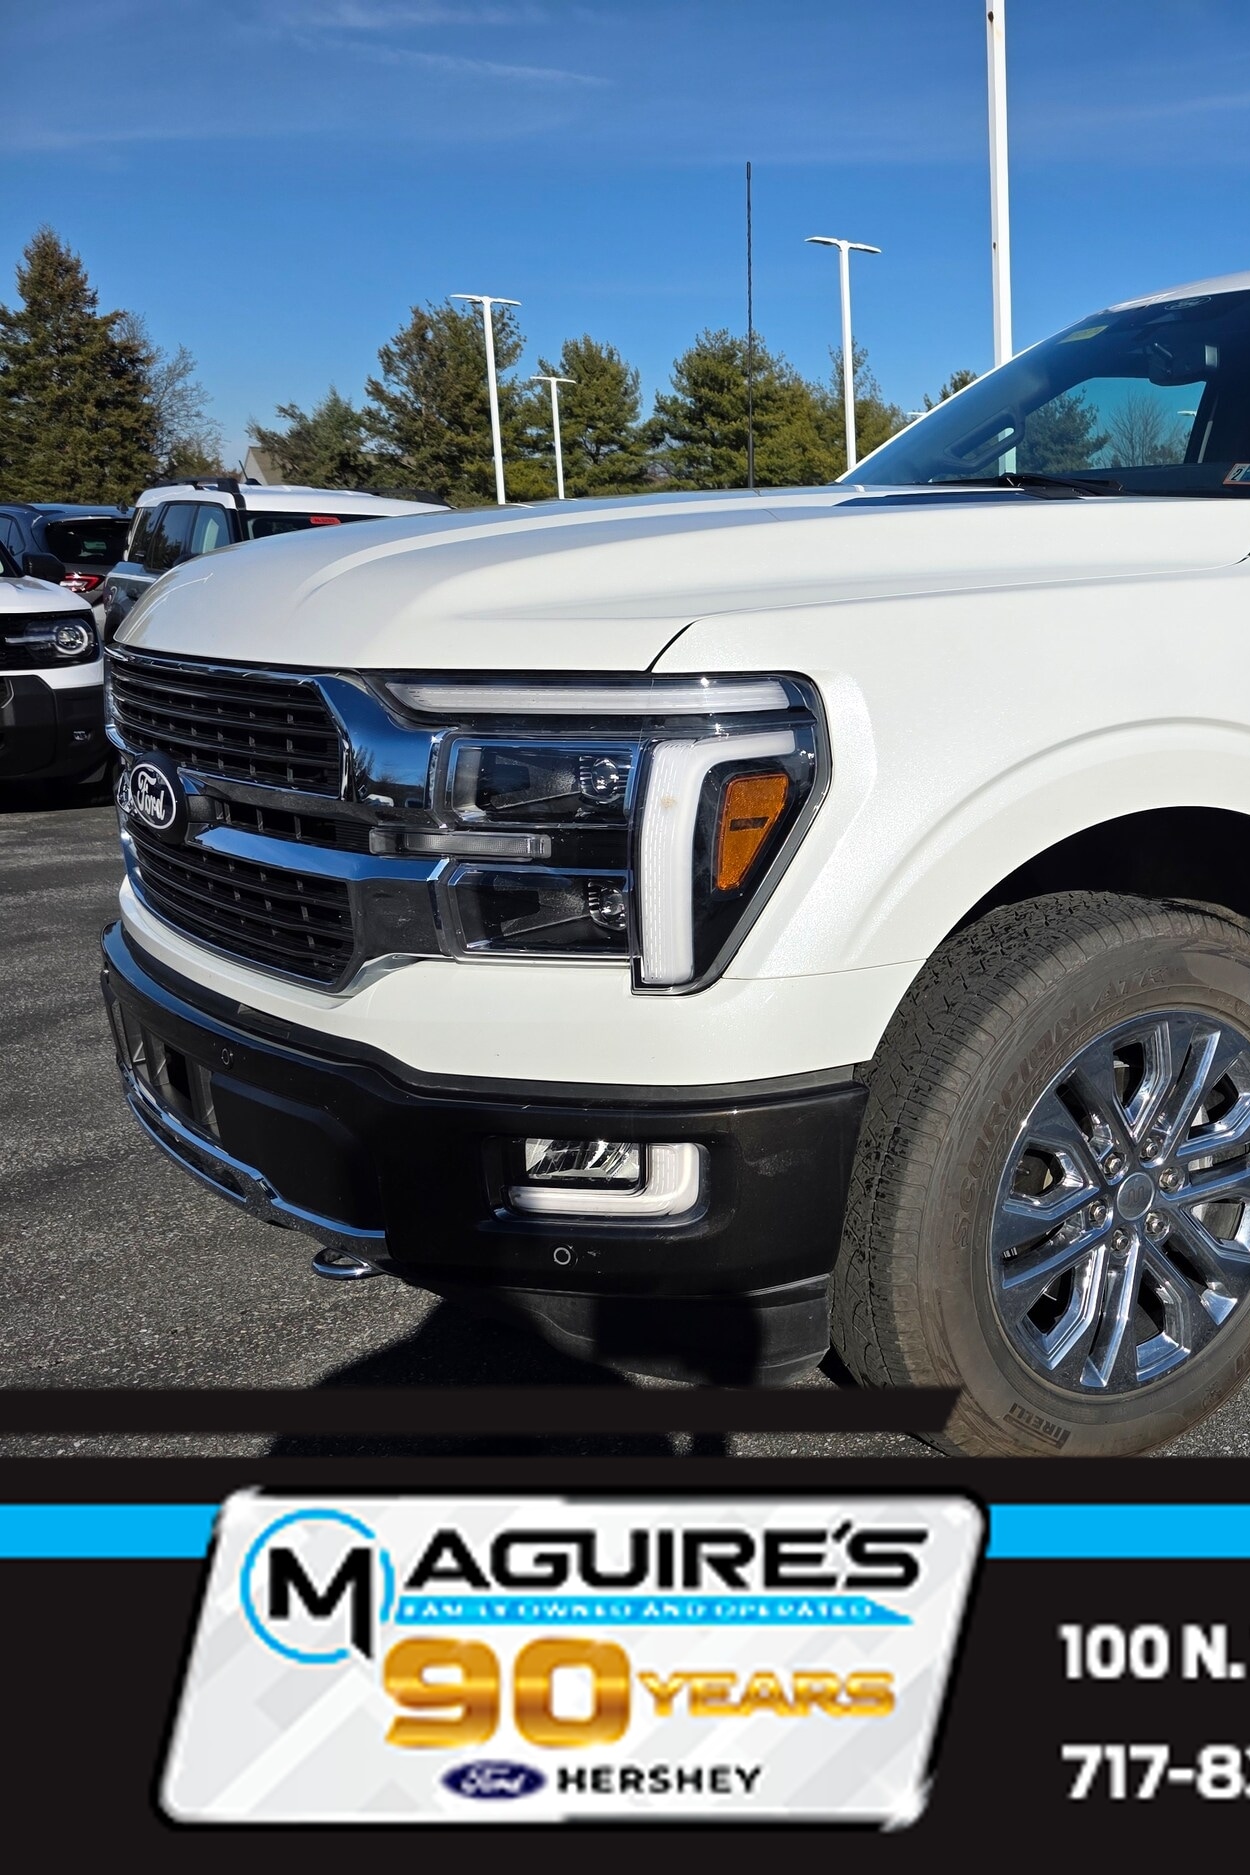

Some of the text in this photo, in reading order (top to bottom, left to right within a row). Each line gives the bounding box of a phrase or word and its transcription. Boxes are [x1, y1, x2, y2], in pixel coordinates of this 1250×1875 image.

[137, 770, 165, 821] Ford
[951, 1003, 1081, 1249] SCORPION
[1002, 1402, 1072, 1450] PIRELLI
